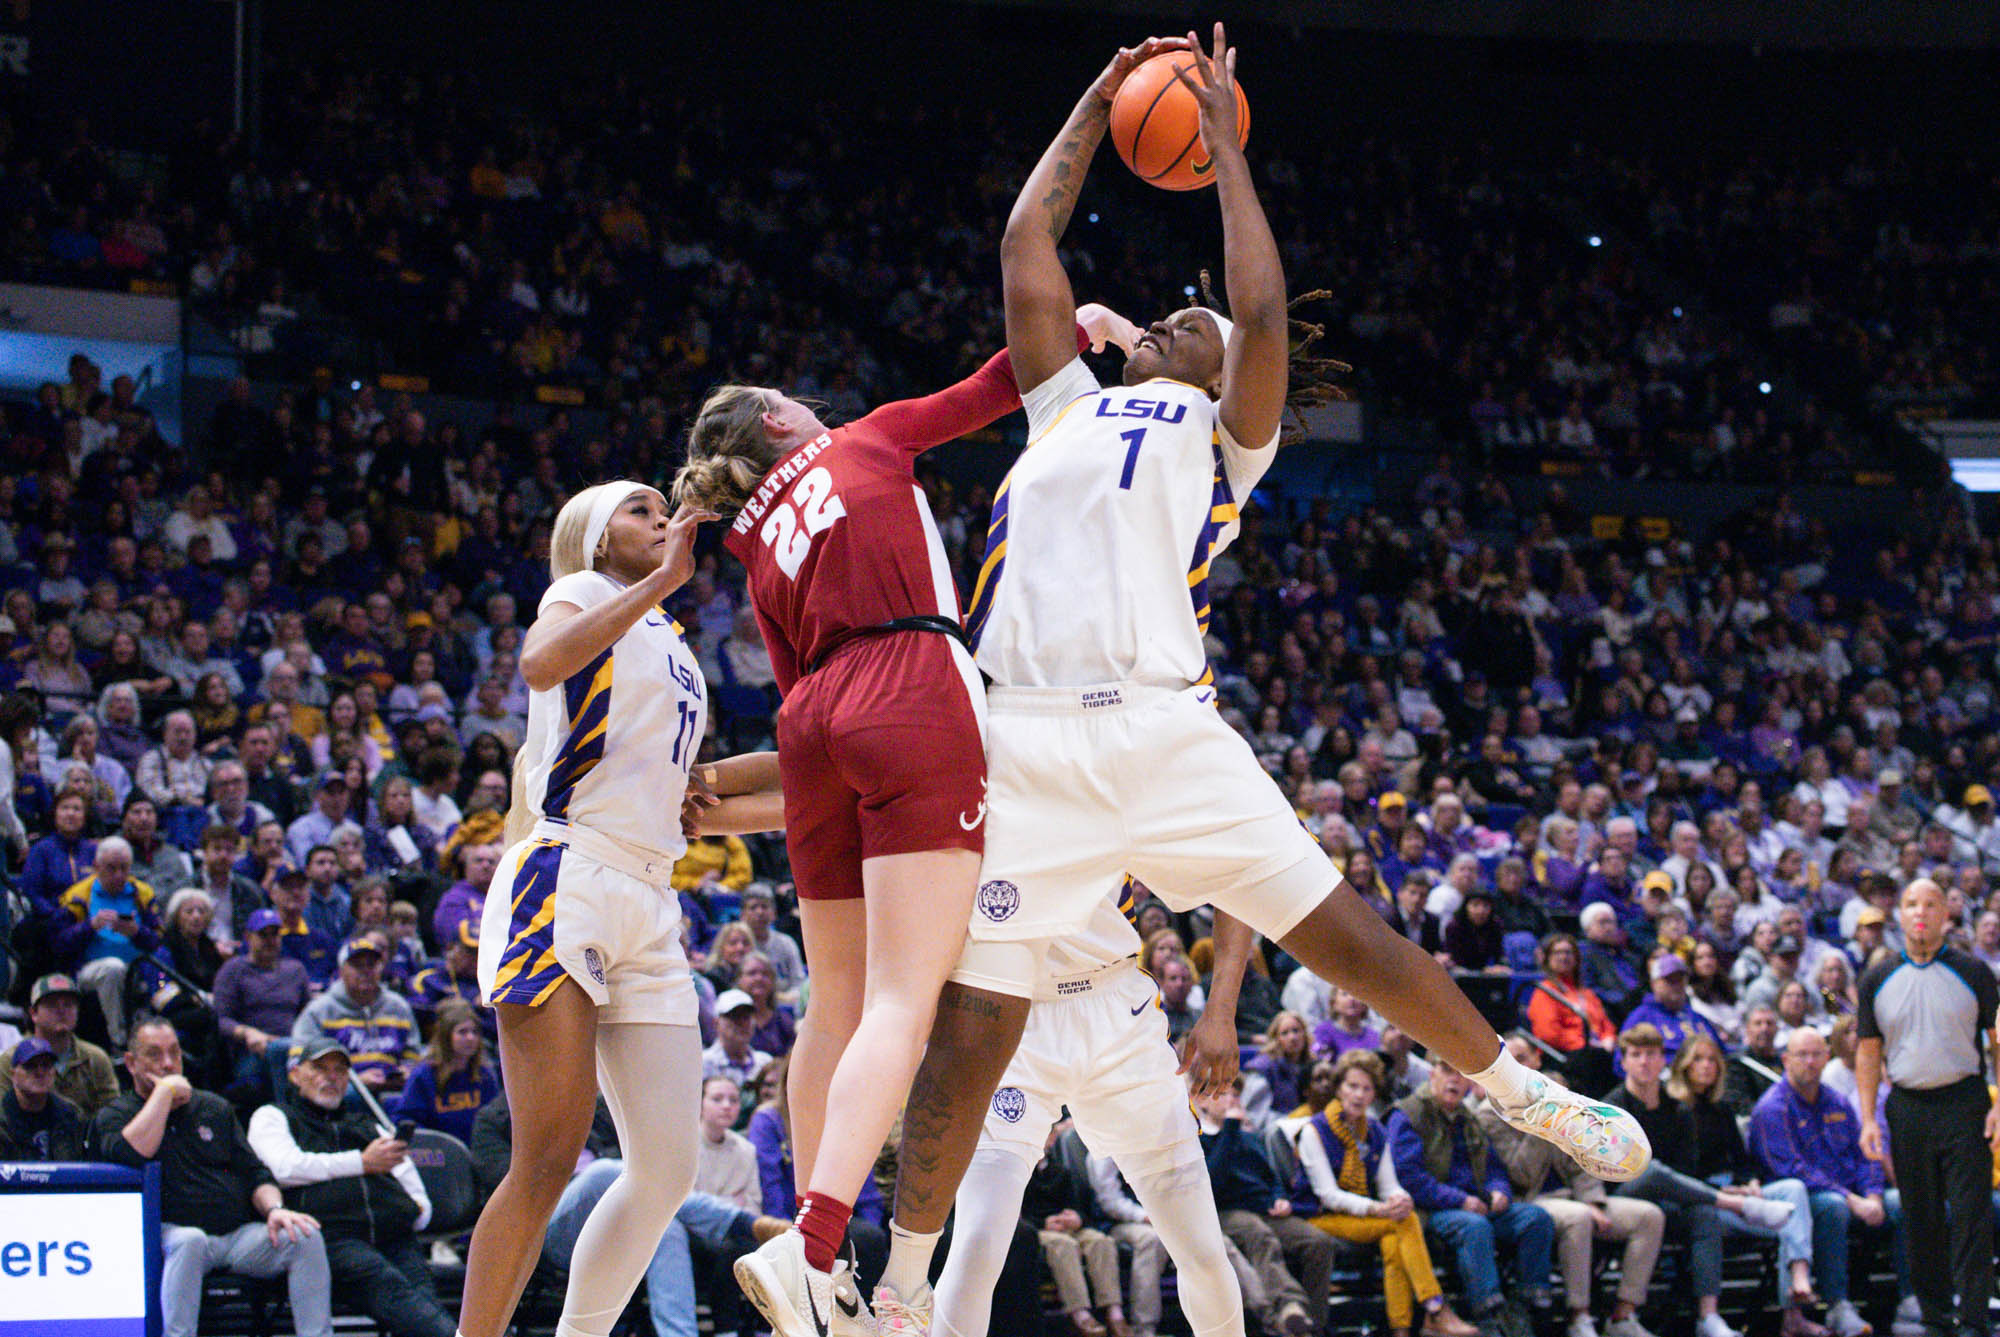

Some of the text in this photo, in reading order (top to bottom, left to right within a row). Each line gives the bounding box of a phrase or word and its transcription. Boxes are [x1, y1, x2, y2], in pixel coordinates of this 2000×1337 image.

[1095, 397, 1188, 424] LSU
[1119, 427, 1148, 490] 1
[731, 432, 833, 535] WEATHERS
[760, 466, 848, 582] 22
[667, 653, 702, 701] LSU
[1080, 698, 1123, 709] TIGERS
[1081, 689, 1120, 701] GEAUX
[671, 700, 698, 774] 11
[1057, 979, 1091, 989] GEAUX
[1057, 985, 1093, 995] TIGERS
[434, 1089, 481, 1115] LSU
[0, 1240, 93, 1277] ers
